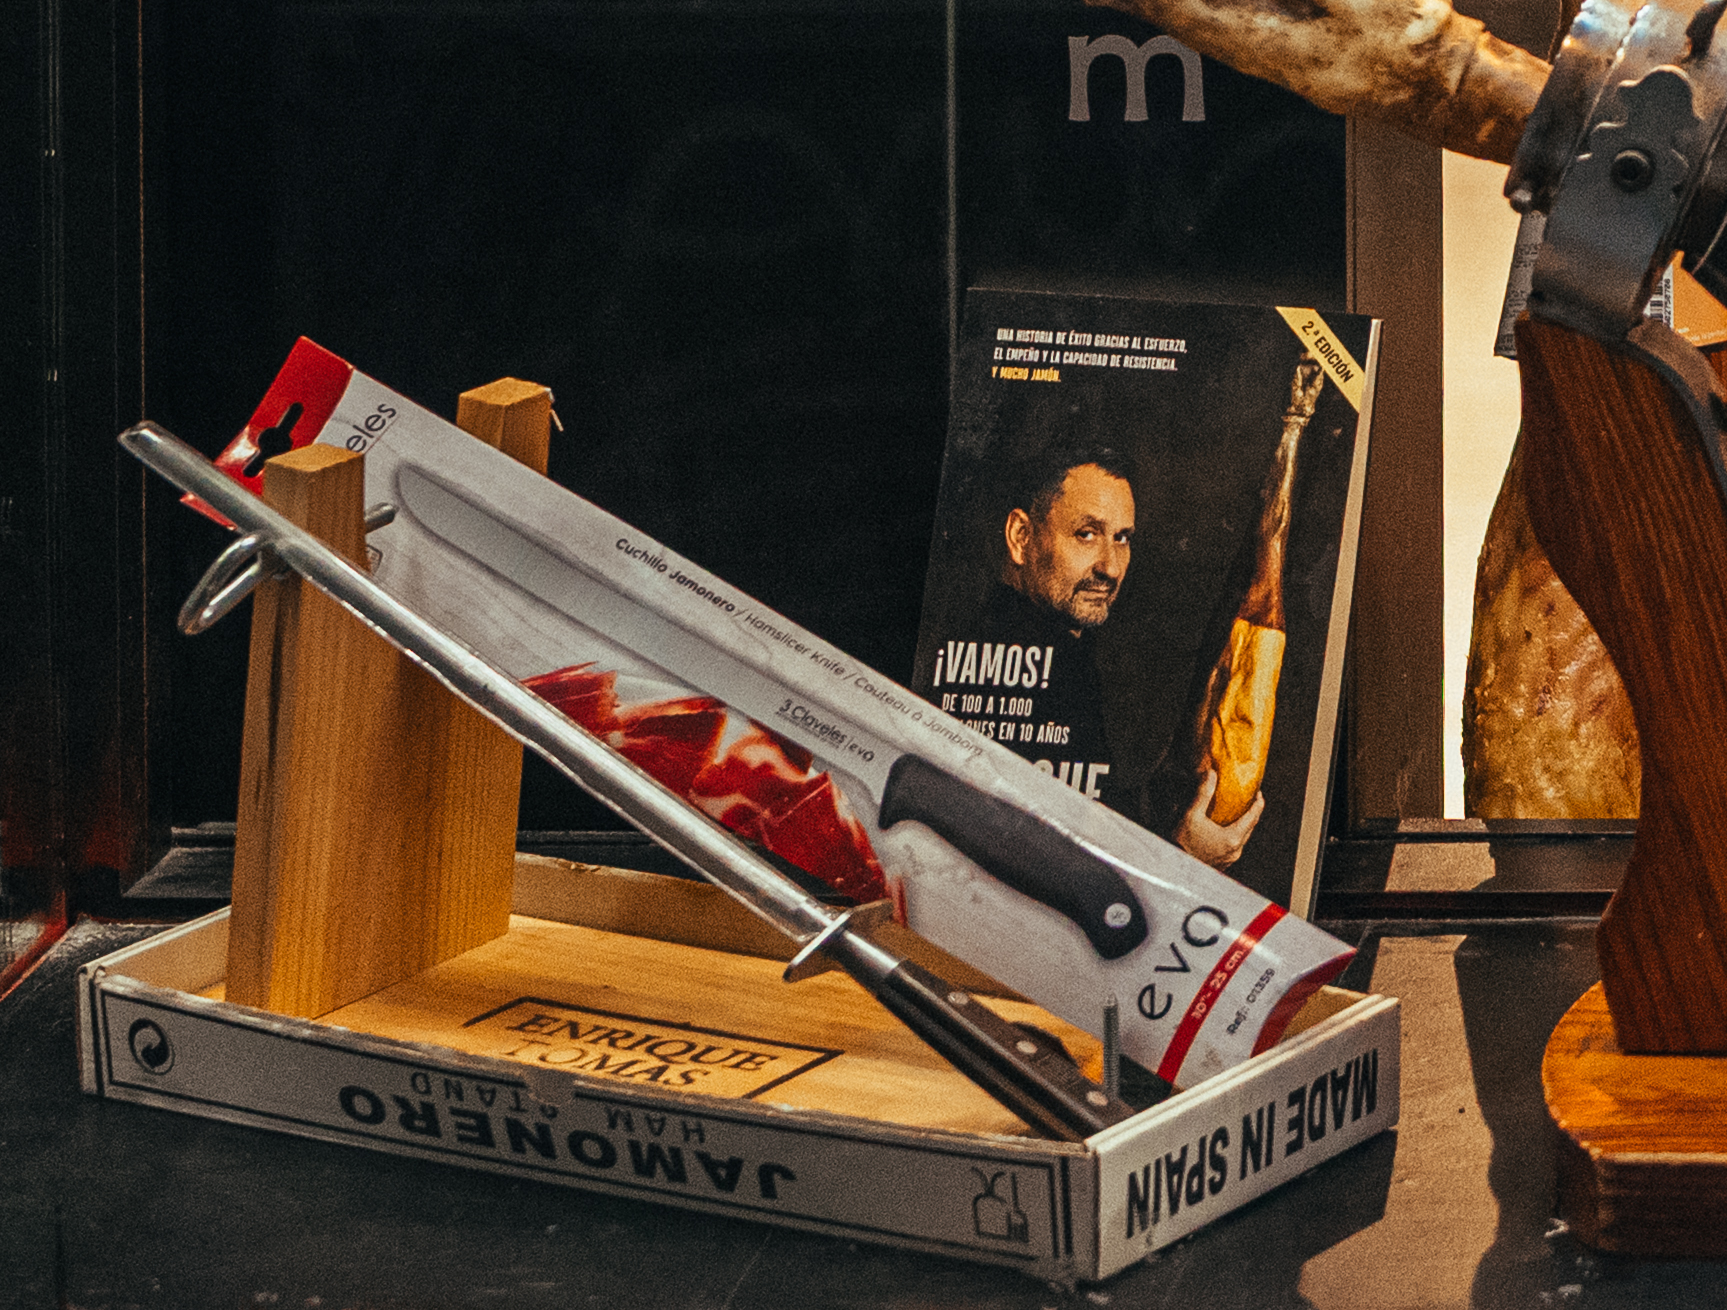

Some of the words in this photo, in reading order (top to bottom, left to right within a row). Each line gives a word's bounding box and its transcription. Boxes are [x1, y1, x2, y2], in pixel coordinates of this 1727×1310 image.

[993, 347, 1004, 361] EL
[1042, 350, 1049, 363] Y
[1050, 350, 1061, 364] LA
[1110, 353, 1121, 367] DE
[1055, 331, 1067, 345] DE
[1068, 330, 1093, 346] ÉXITO
[1094, 334, 1130, 349] GRACIAS
[1131, 335, 1142, 350] AL
[1312, 333, 1355, 384] EDICIÓN
[615, 537, 669, 574] Cuchillo
[668, 569, 736, 613] Jamonero
[744, 612, 811, 655] Hamslicer
[810, 648, 846, 677] Knife
[933, 640, 1054, 689] ¡VAMOS!
[790, 704, 848, 744] Claveles
[942, 693, 958, 712] DE
[961, 694, 983, 713] 100
[985, 695, 994, 714] A
[999, 696, 1033, 717] 1.000
[998, 721, 1016, 741] EN
[1019, 723, 1034, 742] 10
[1036, 721, 1071, 745] AÑOS
[1136, 904, 1230, 1021] evo
[1209, 968, 1228, 991] 25
[1224, 948, 1246, 972] cm
[507, 1013, 779, 1073] ENRIQUE
[606, 1106, 706, 1143] HAM
[1285, 1046, 1379, 1160] MADE
[339, 1085, 798, 1200] JAMONERO
[1239, 1100, 1276, 1182] IN
[1126, 1125, 1231, 1240] SPAIN
